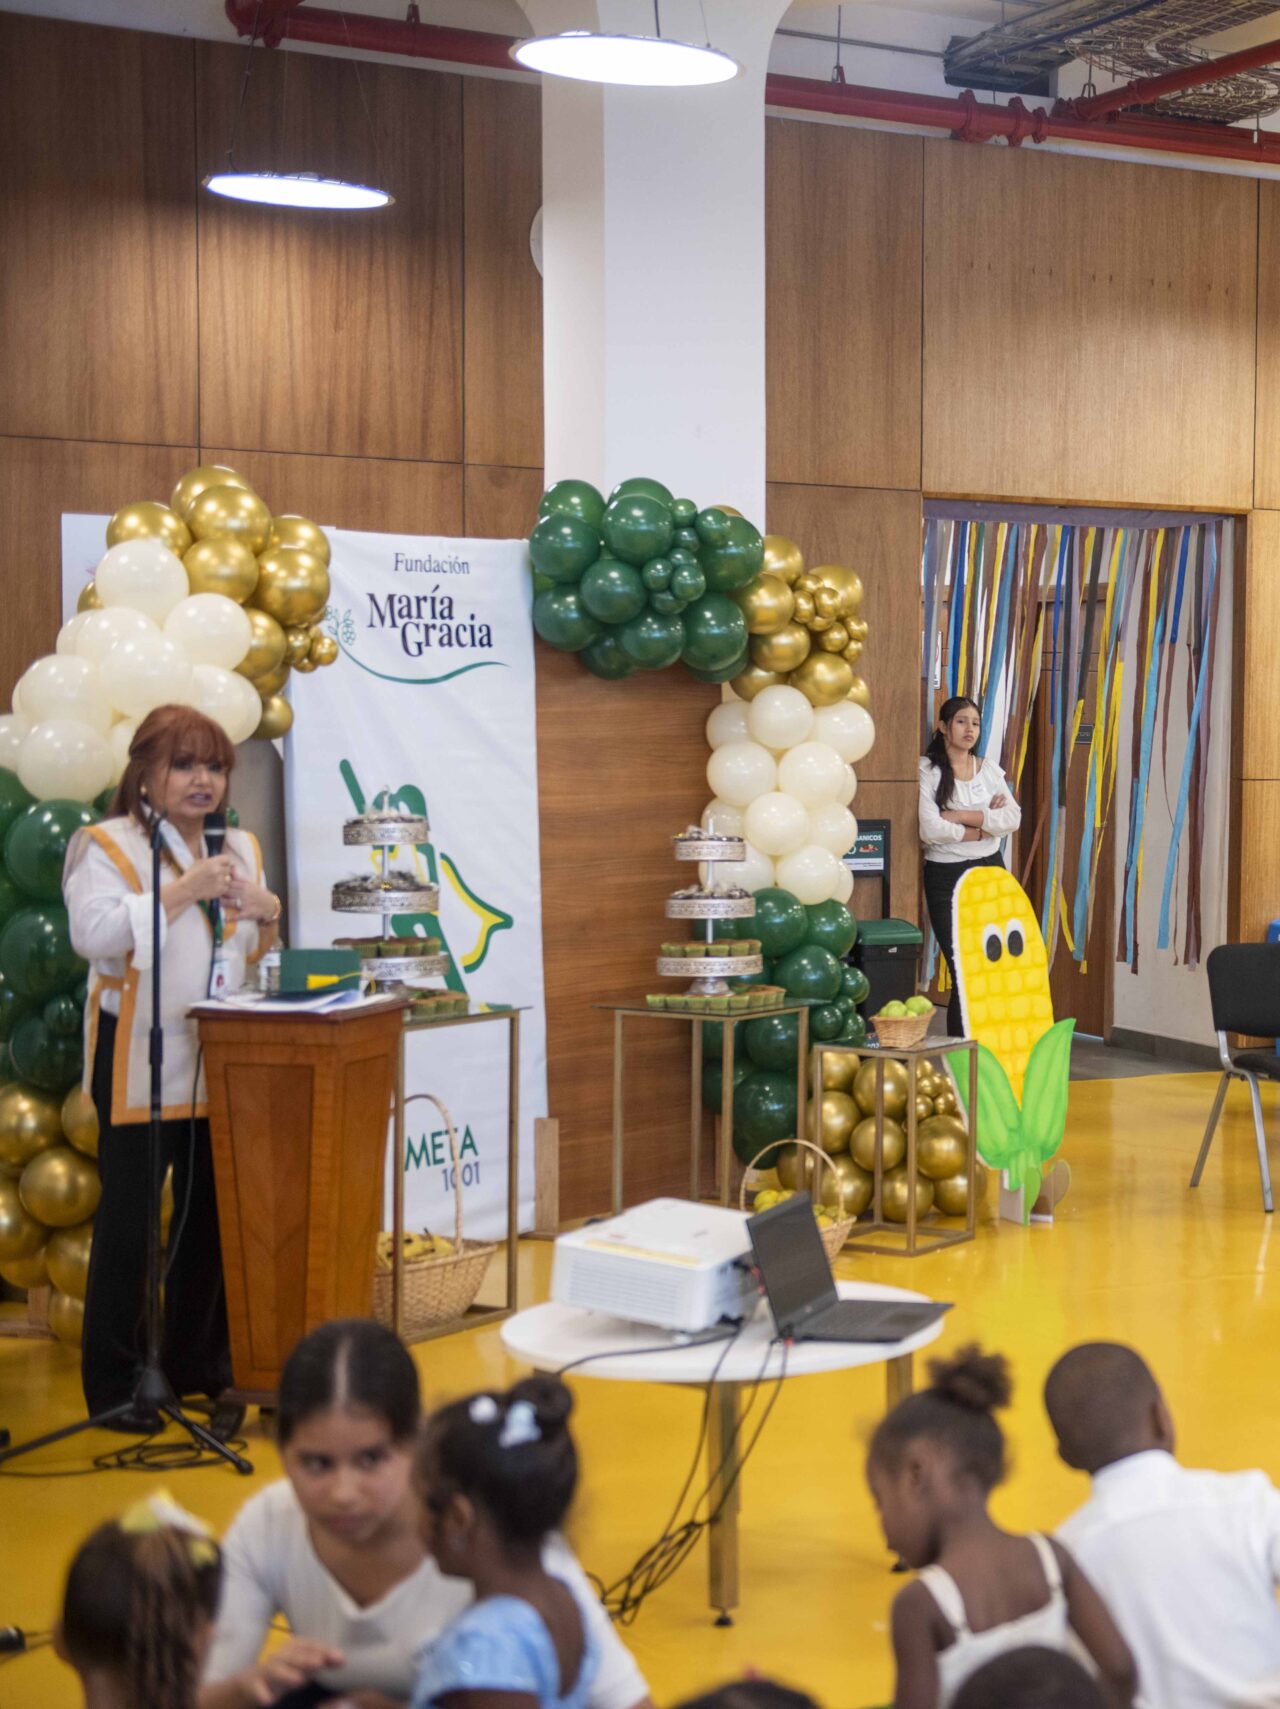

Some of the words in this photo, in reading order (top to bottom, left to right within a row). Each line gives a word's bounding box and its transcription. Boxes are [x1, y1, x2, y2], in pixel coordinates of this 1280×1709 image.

[394, 552, 470, 575] Fundación
[366, 584, 455, 629] María
[401, 613, 493, 658] Gracia
[404, 1124, 479, 1172] META
